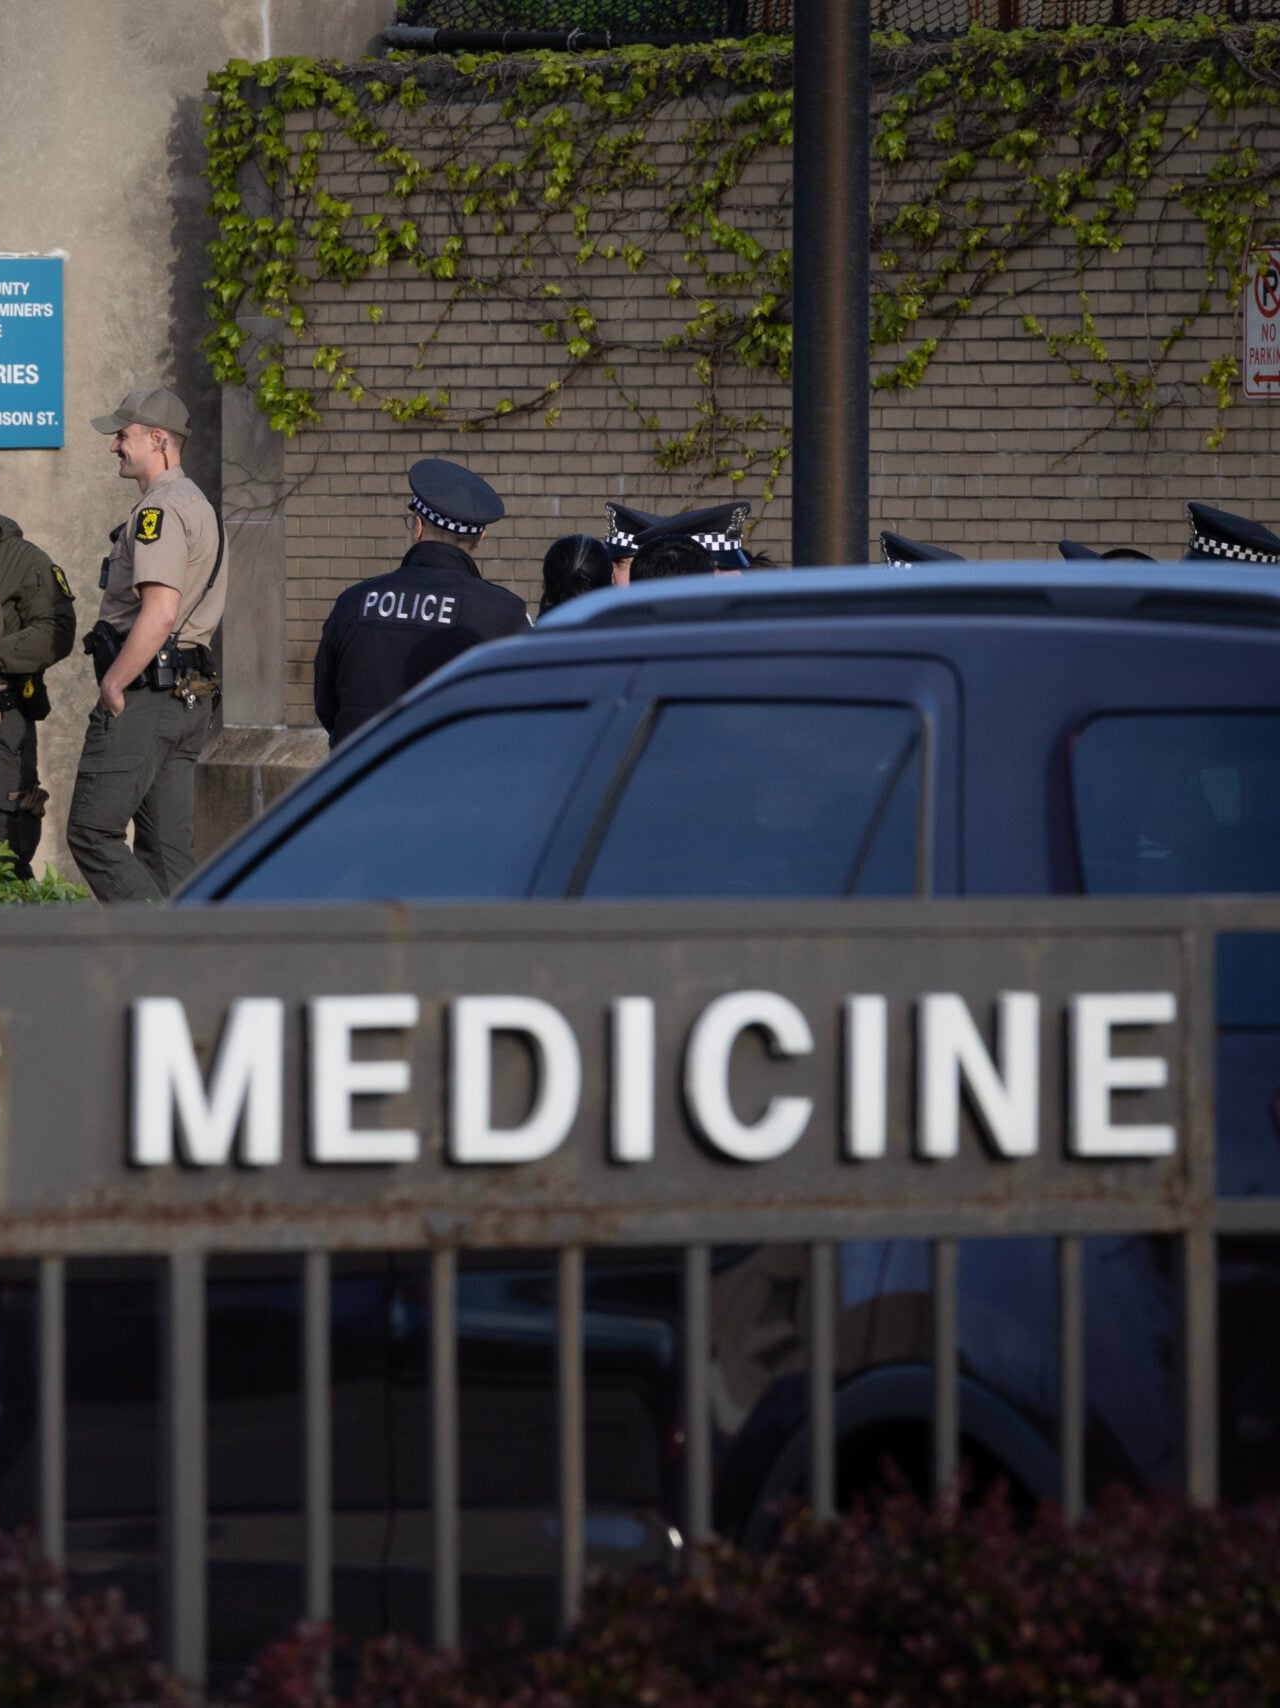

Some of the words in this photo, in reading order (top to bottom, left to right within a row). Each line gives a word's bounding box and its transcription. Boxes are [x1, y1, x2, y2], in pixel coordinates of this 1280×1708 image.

[1261, 323, 1276, 342] NO
[1249, 347, 1280, 366] PARKIN
[36, 411, 59, 426] ST.
[363, 591, 456, 624] POLICE
[130, 989, 1177, 1168] MEDICINE
